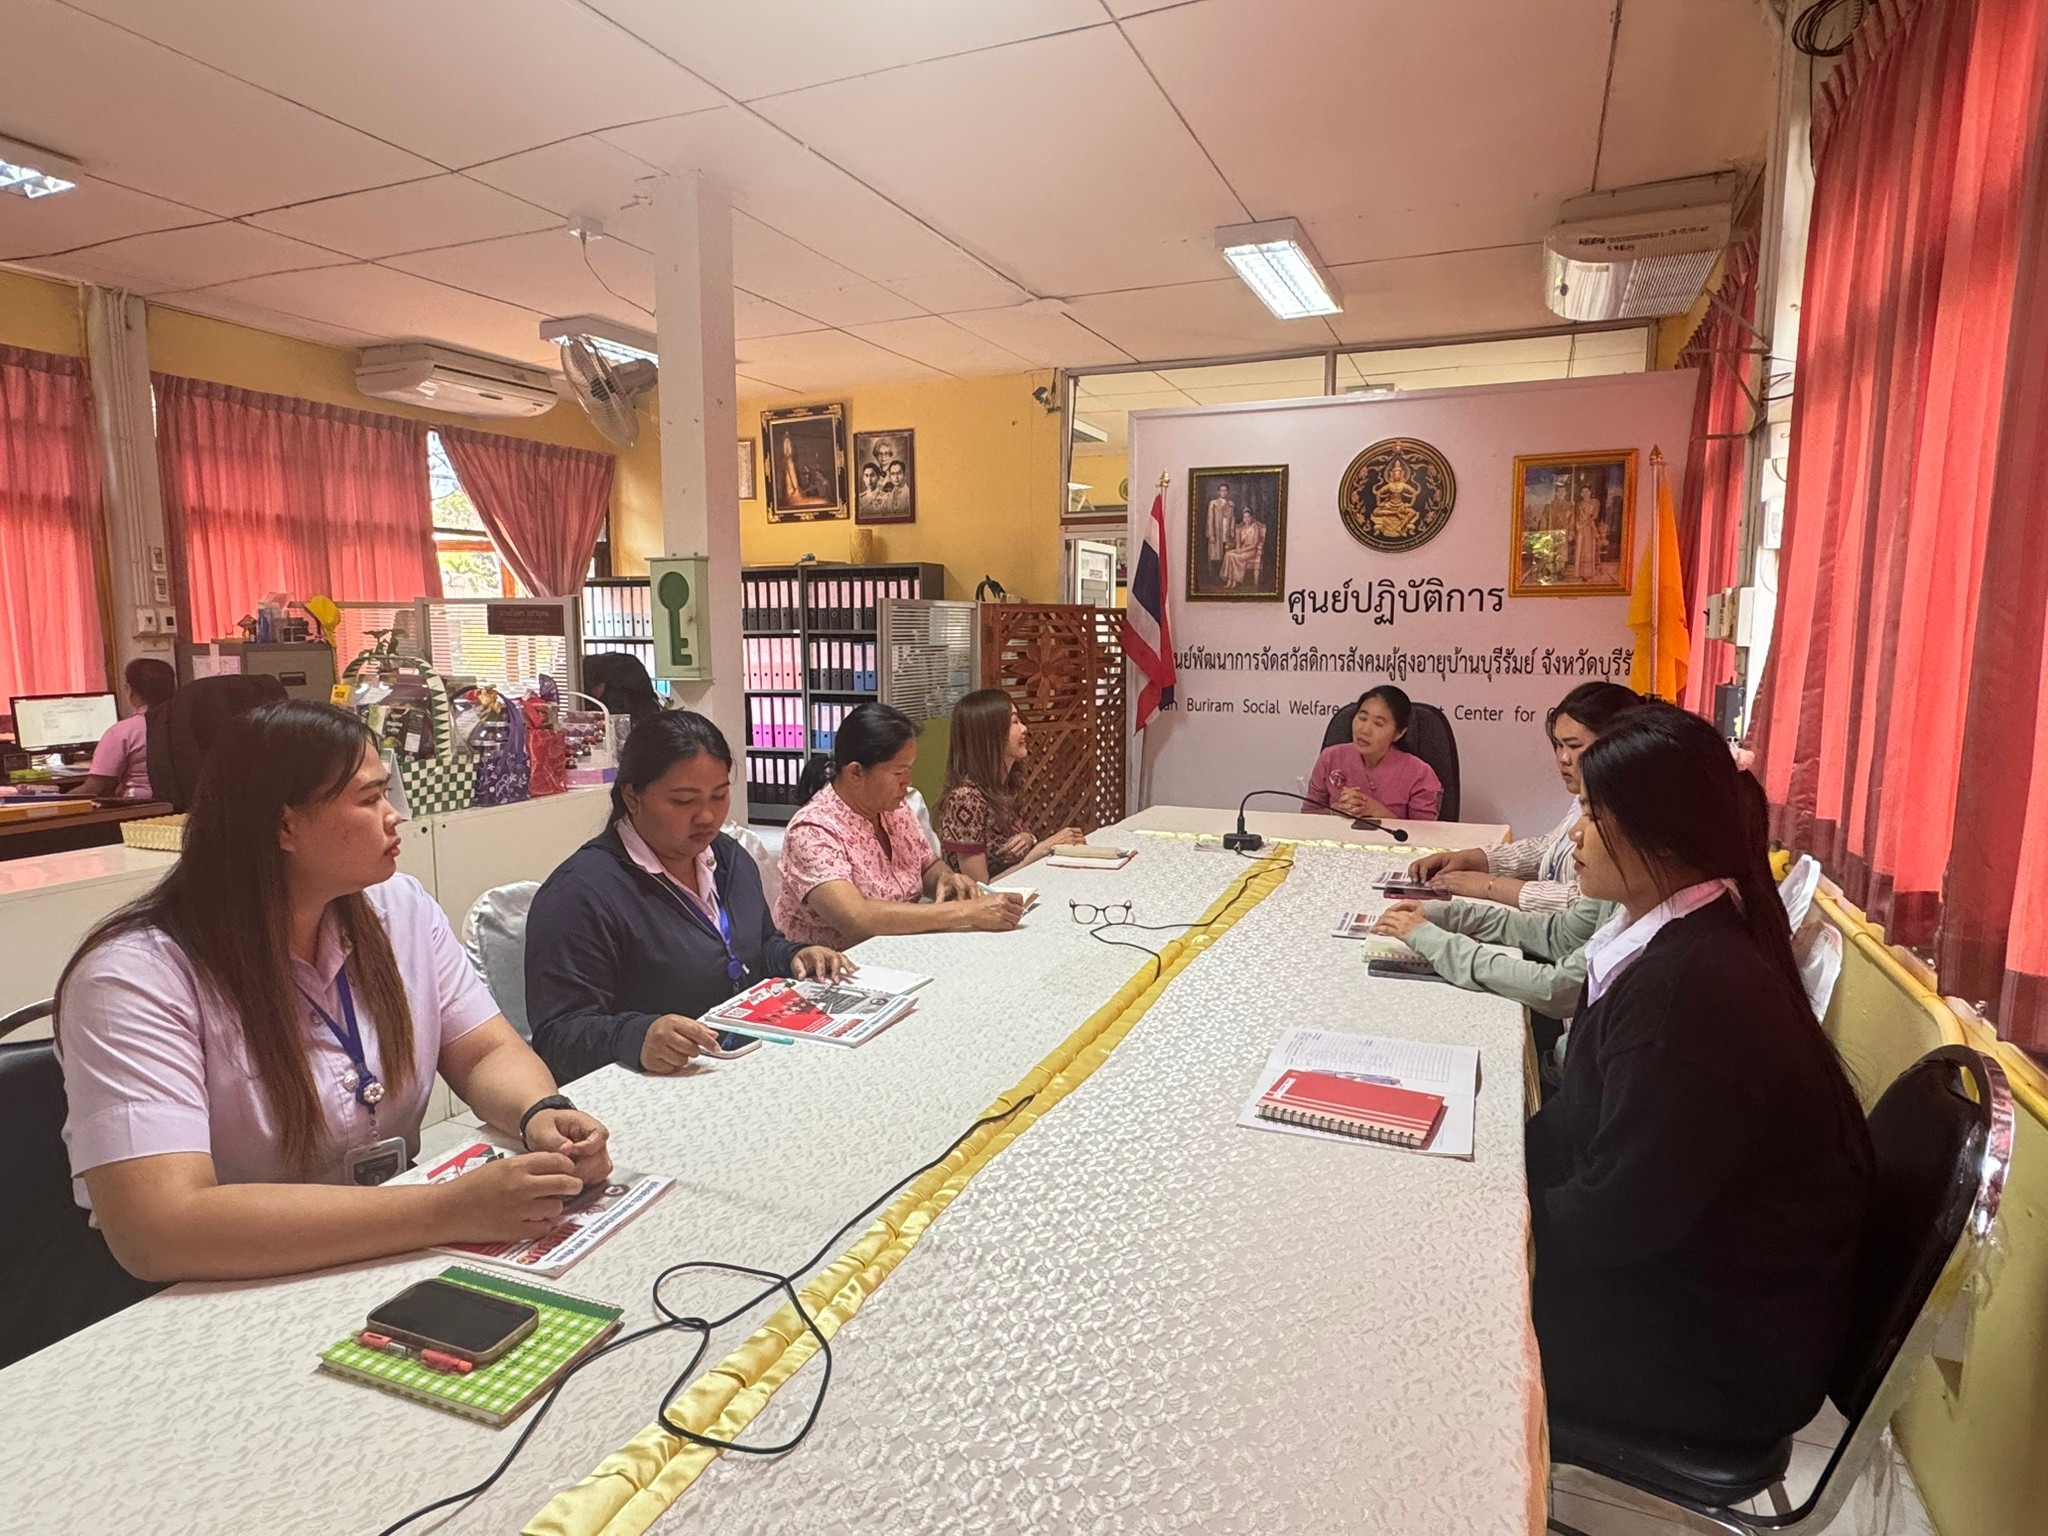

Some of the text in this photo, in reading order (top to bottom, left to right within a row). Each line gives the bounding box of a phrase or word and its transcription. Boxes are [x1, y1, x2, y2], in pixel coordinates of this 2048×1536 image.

[1288, 577, 1505, 626] ศูนย์ปฏิบัติการ
[1173, 644, 1635, 684] นย์พัฒนาการจัดสวัสดิการสังคมผู้สูงอายุบ้านบุรีรัมย์ จังหวัดบุรีรั
[1187, 697, 1234, 713] Buriram
[1243, 698, 1281, 715] Social
[1289, 699, 1340, 716] Welfare
[1454, 704, 1504, 721] Center
[1514, 705, 1537, 723] for
